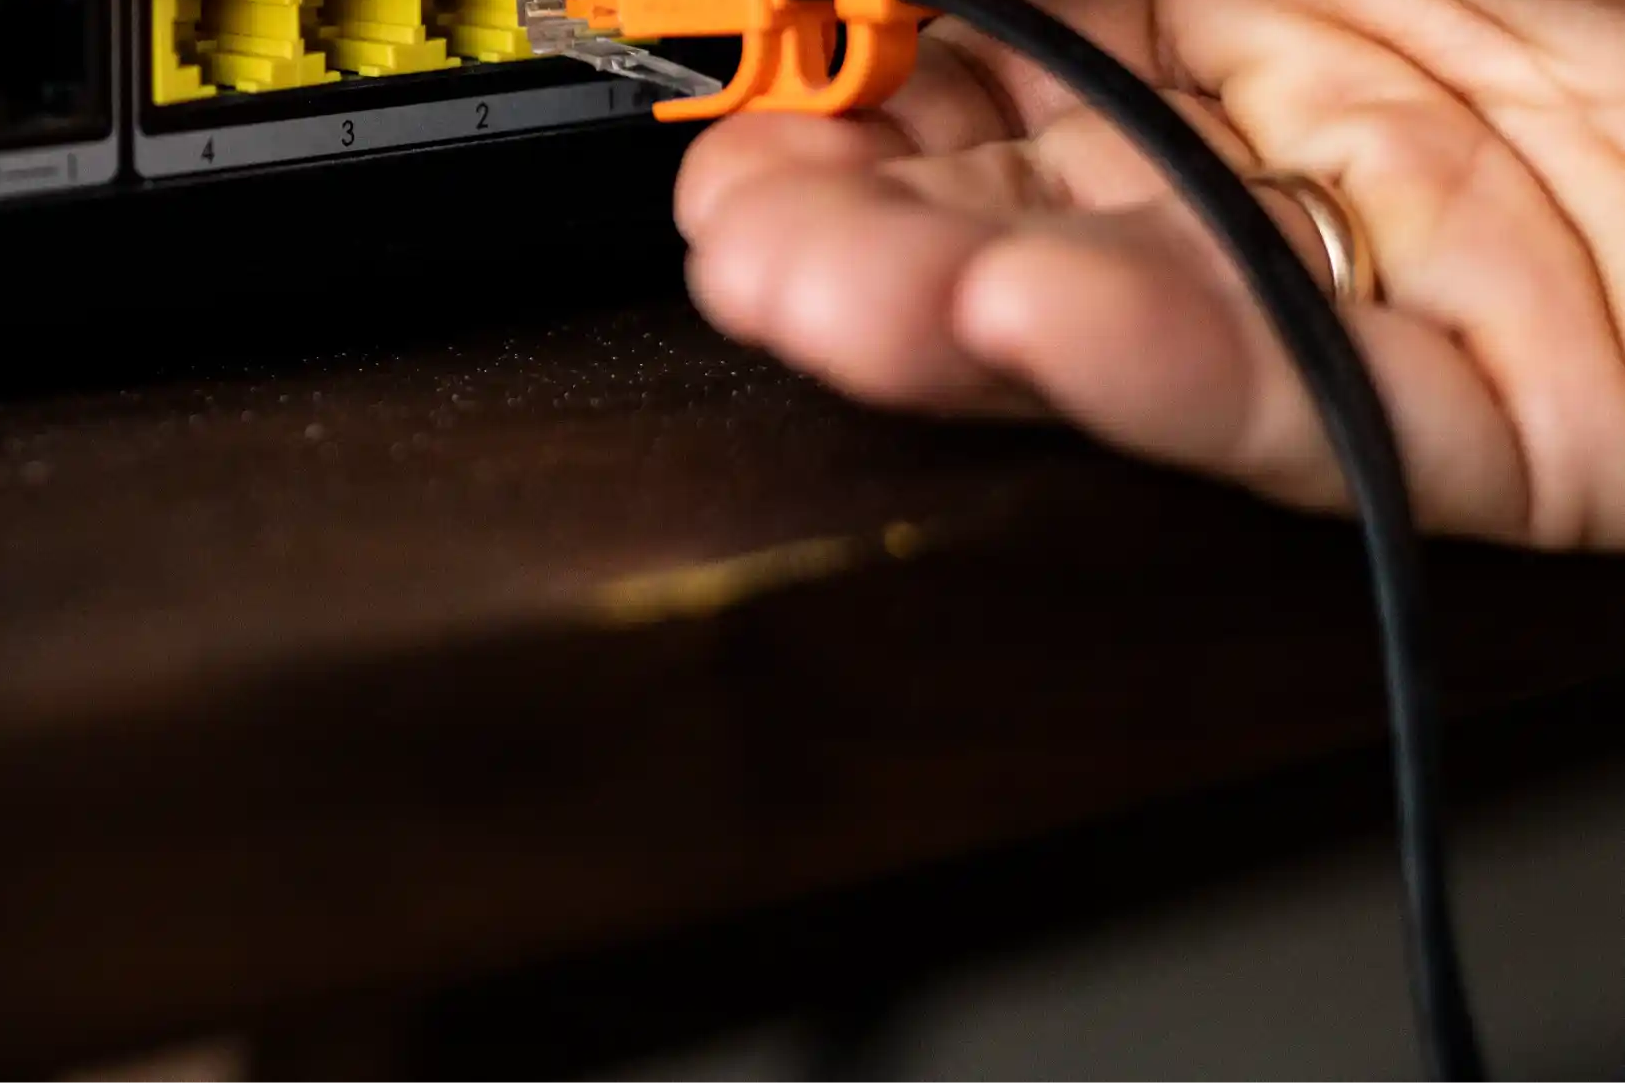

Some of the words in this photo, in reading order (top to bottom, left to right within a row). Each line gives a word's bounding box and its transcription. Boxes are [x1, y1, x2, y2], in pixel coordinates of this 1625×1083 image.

[200, 135, 215, 164] 4
[340, 119, 356, 147] 3
[475, 102, 489, 129] 2
